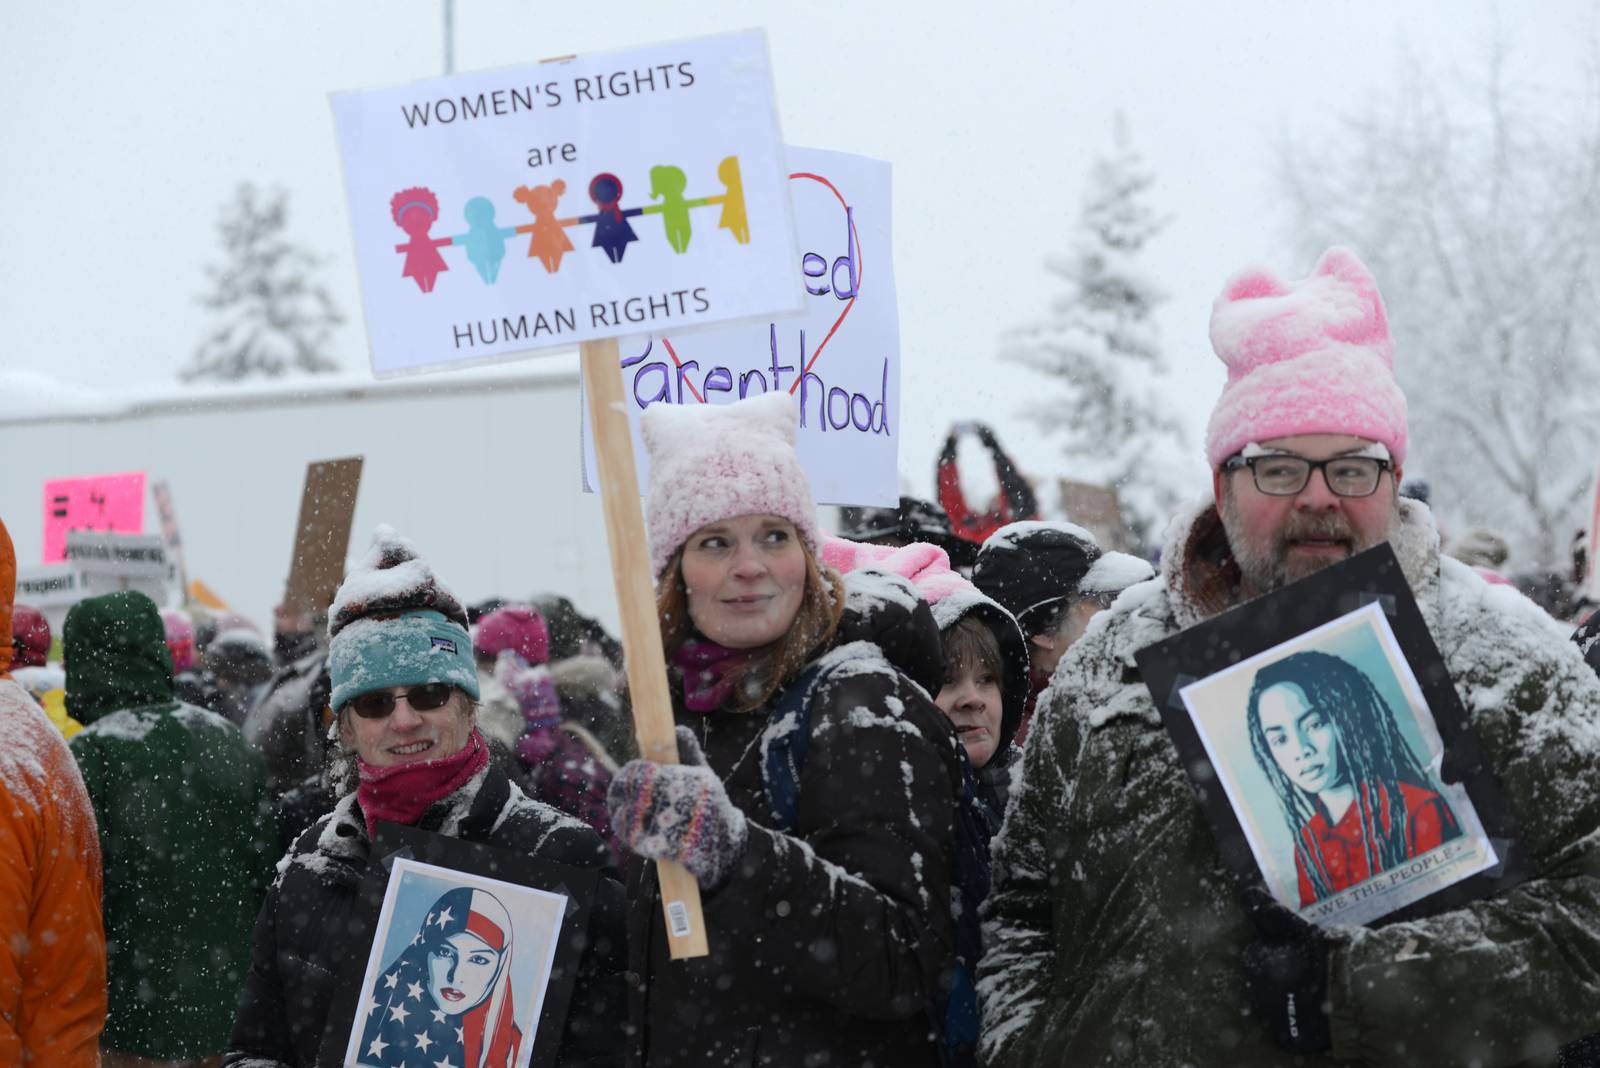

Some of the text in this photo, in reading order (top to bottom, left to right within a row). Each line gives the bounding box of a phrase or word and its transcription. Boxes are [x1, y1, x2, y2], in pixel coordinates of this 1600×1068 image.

[402, 61, 695, 129] WOMEN'S RIGHTS
[527, 143, 577, 168] are
[801, 206, 859, 302] ed
[453, 287, 709, 349] HUMAN RIGHTS
[620, 323, 892, 437] arenthood
[1317, 897, 1348, 917] WE
[1350, 881, 1387, 903] THE
[1389, 846, 1456, 885] PEOPLE
[1287, 992, 1298, 1038] HEAD
